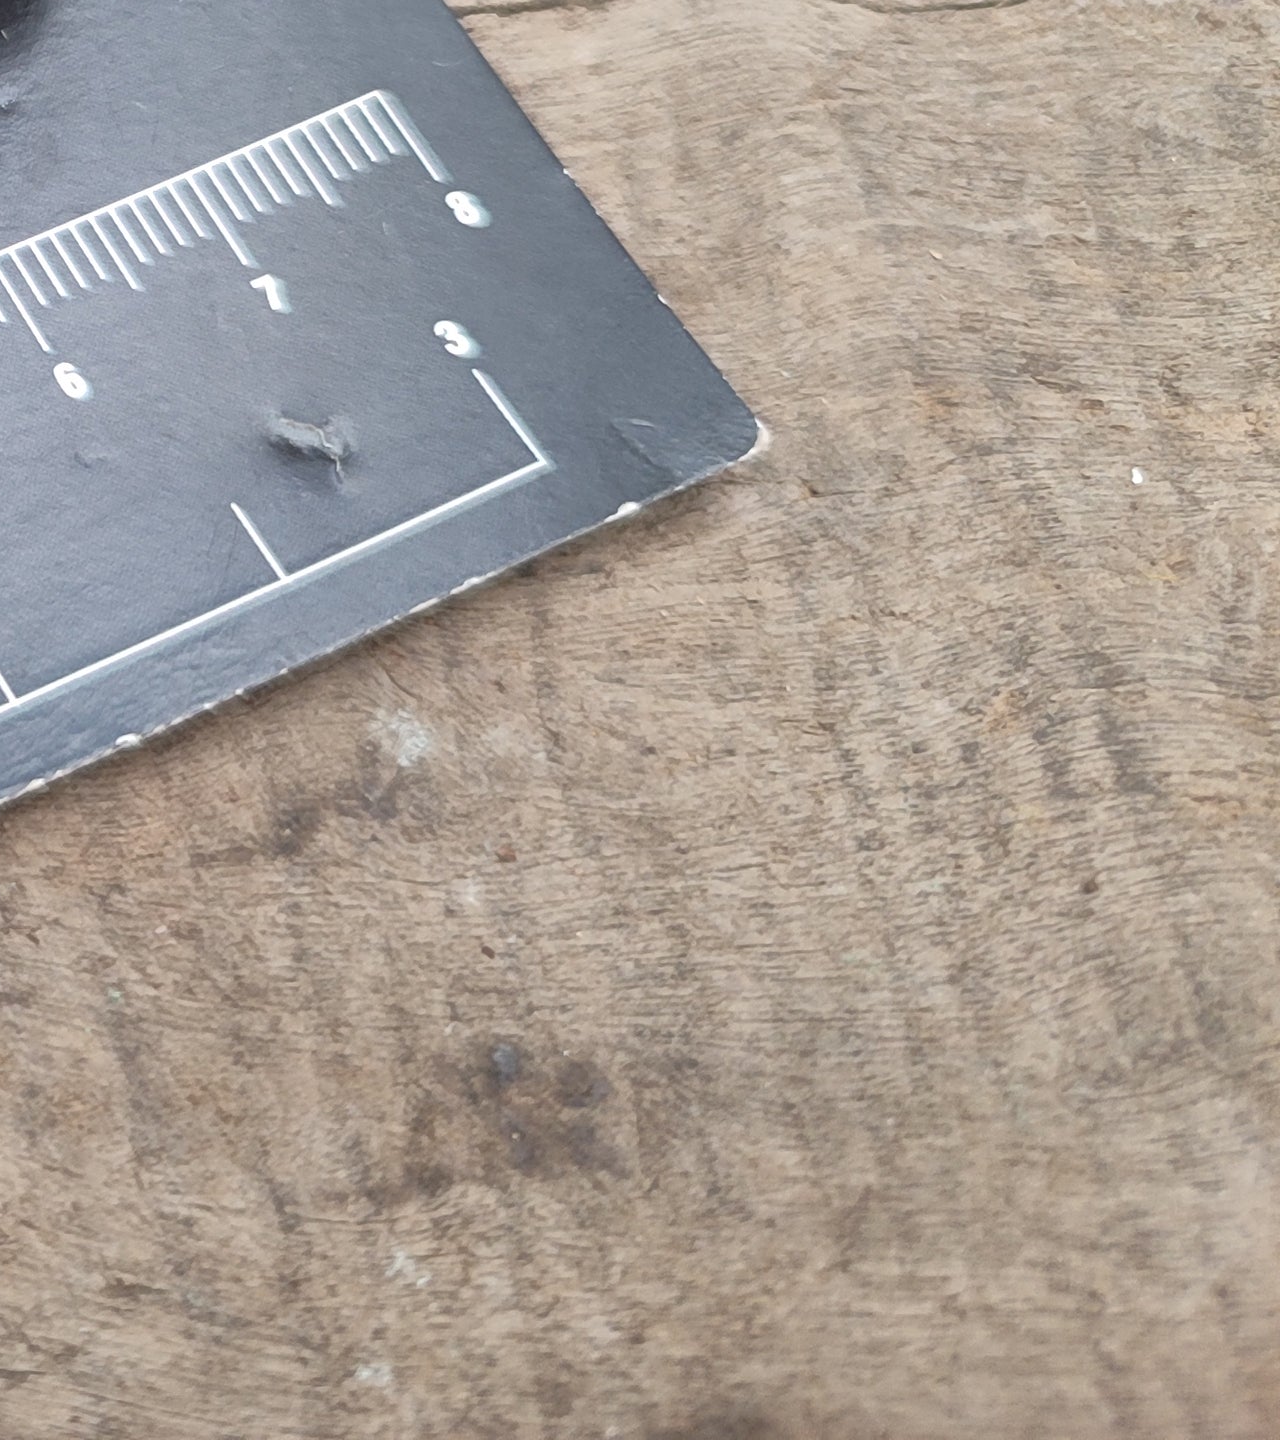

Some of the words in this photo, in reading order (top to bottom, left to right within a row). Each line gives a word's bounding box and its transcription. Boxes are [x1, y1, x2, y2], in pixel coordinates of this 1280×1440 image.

[53, 361, 90, 400] 6
[249, 273, 288, 312] 7
[445, 190, 483, 227] 8
[433, 320, 474, 357] 3
